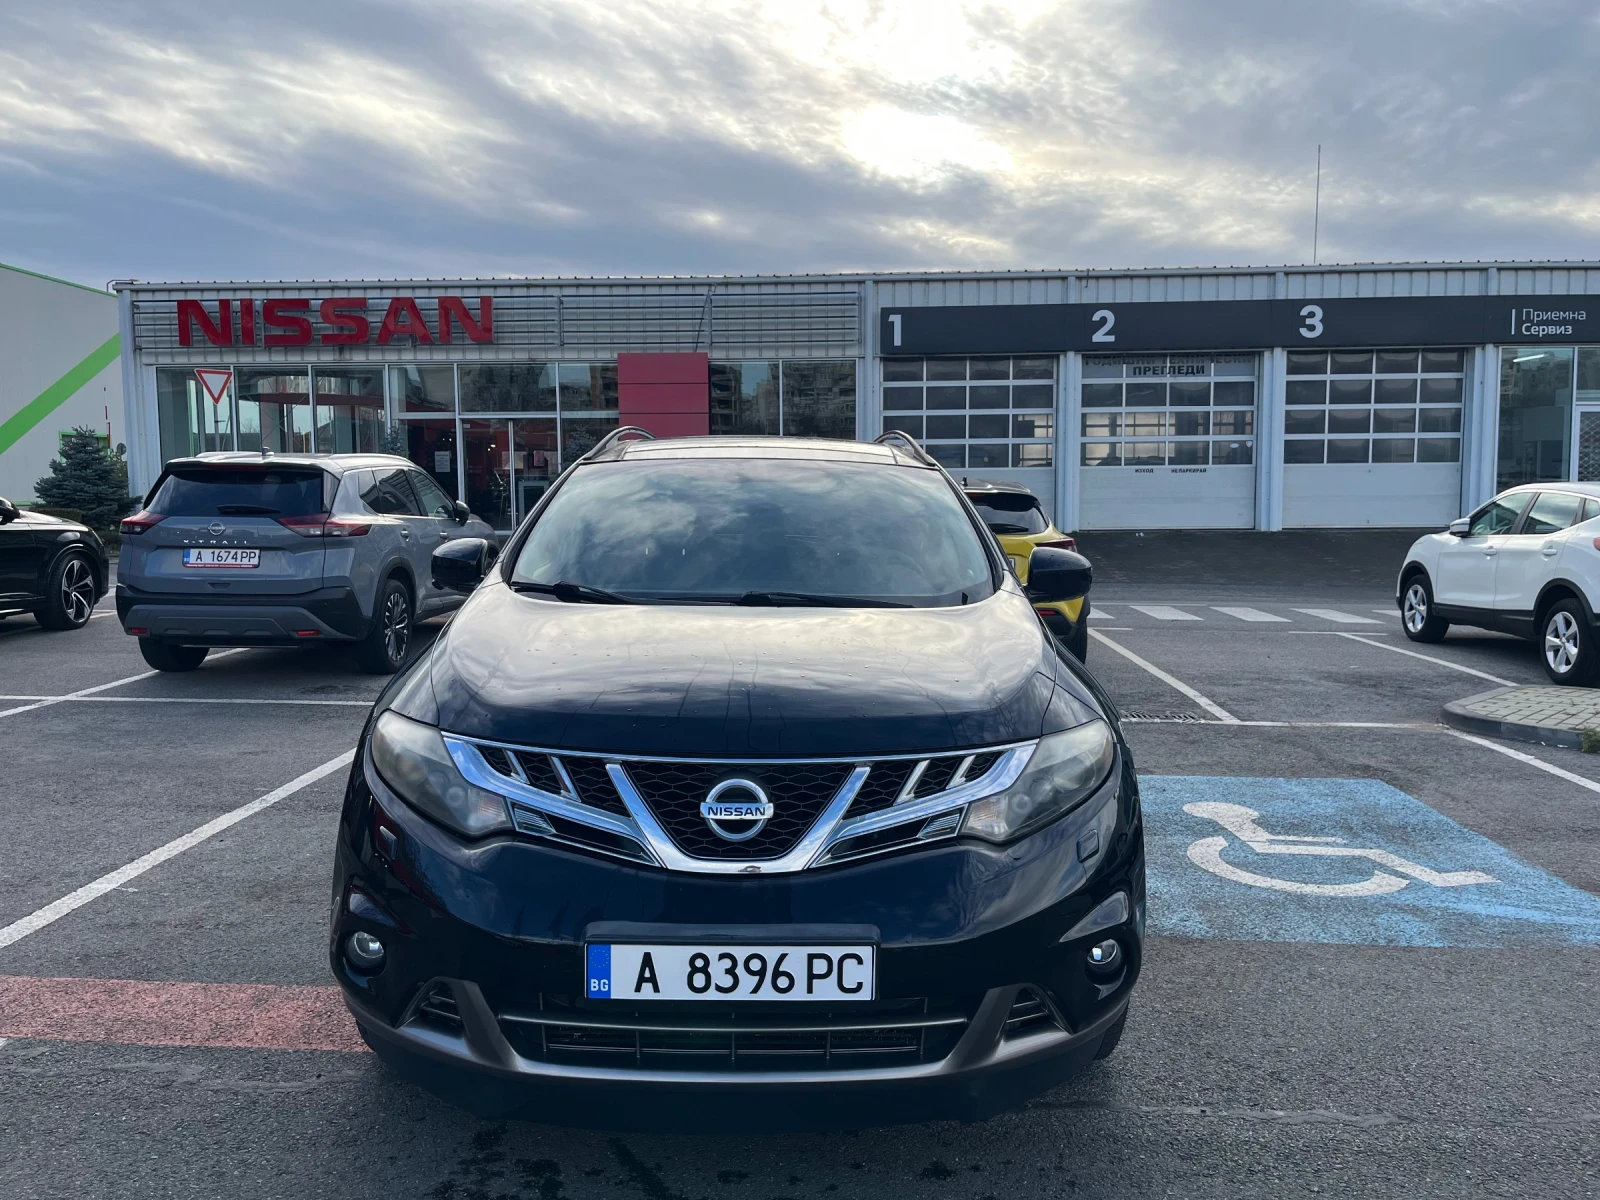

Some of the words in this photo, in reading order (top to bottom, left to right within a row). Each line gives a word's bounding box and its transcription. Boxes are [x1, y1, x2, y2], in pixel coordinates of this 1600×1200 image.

[176, 295, 494, 346] NISSAN
[1091, 309, 1116, 343] 2
[1299, 304, 1324, 339] 3
[1522, 308, 1587, 323] Приемна
[888, 314, 902, 346] 1
[1521, 322, 1573, 338] Сервиз
[1132, 365, 1205, 376] ПРЕГЛЕДИ
[195, 550, 203, 562] A
[707, 806, 766, 817] NISSAN
[590, 979, 609, 992] BG
[633, 951, 661, 994] A
